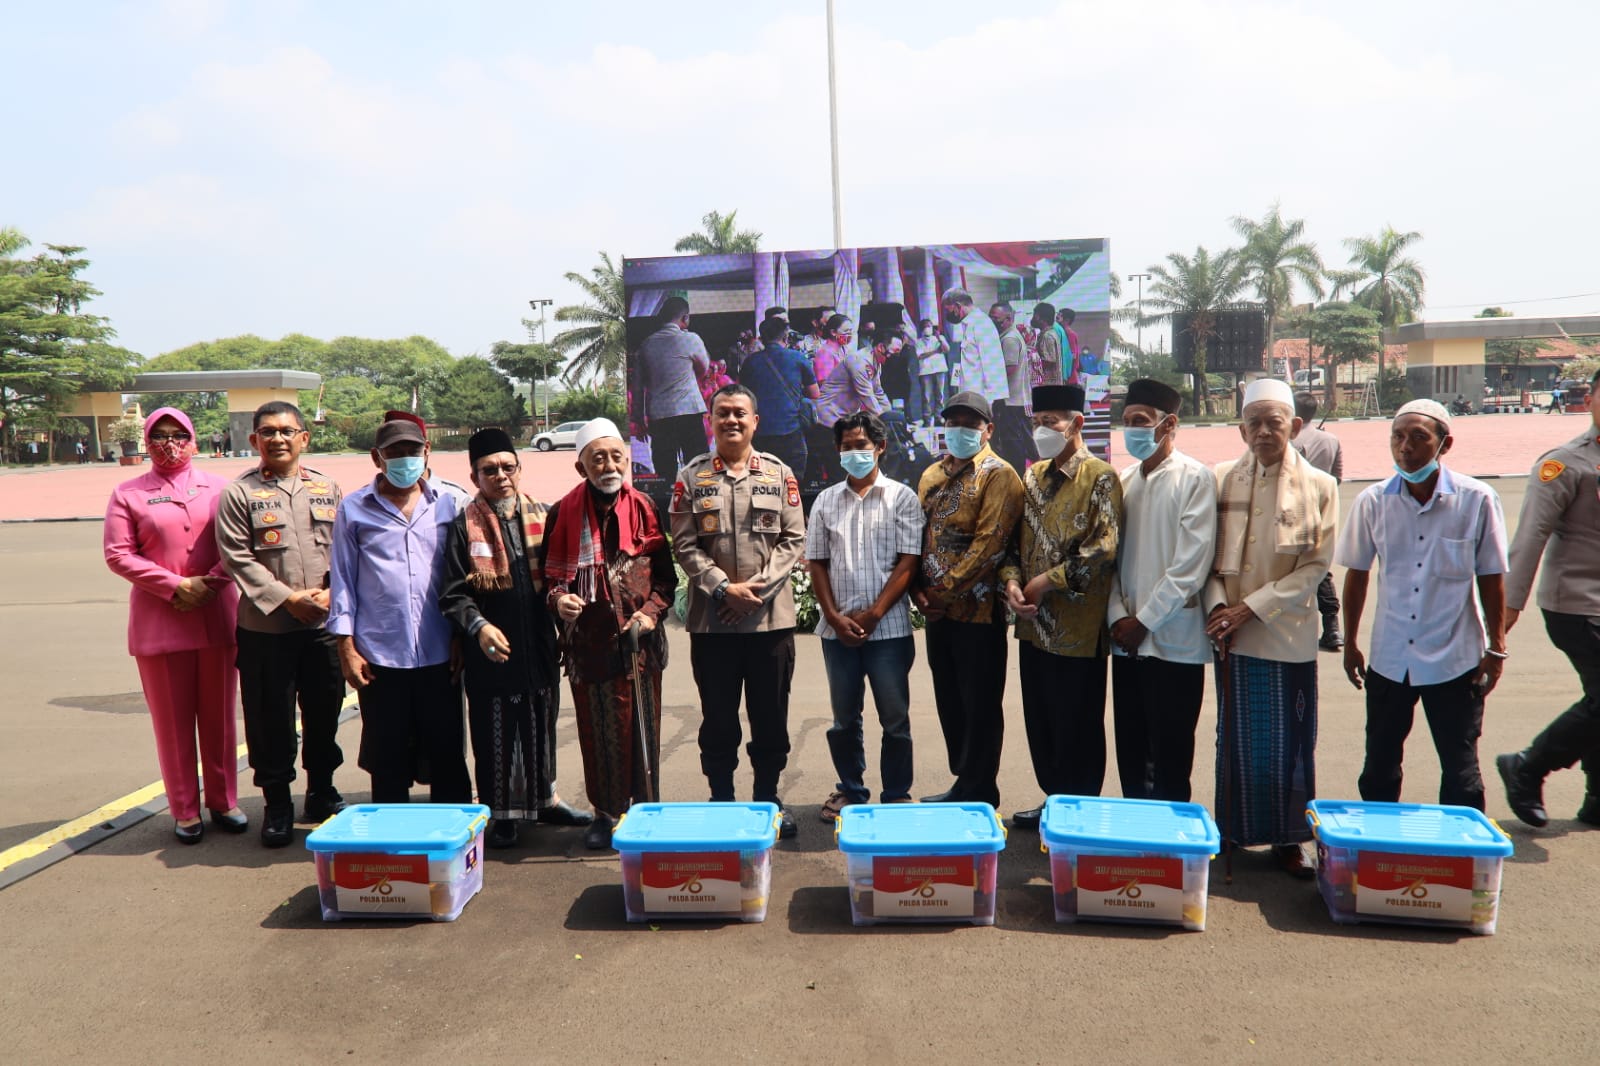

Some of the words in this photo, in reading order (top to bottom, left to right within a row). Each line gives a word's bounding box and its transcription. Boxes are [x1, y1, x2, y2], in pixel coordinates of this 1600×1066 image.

[694, 486, 720, 498] RUDY
[752, 486, 781, 496] POLRI
[309, 497, 335, 505] POLRI
[381, 896, 406, 904] BANTEN
[690, 895, 716, 903] BANTEN
[898, 899, 920, 907] POLDA
[922, 899, 948, 907] BANTEN
[1103, 898, 1126, 906] POLDA
[1127, 899, 1156, 908] BANTEN
[1385, 898, 1410, 906] POLDA
[1411, 899, 1442, 908] BANTEN
